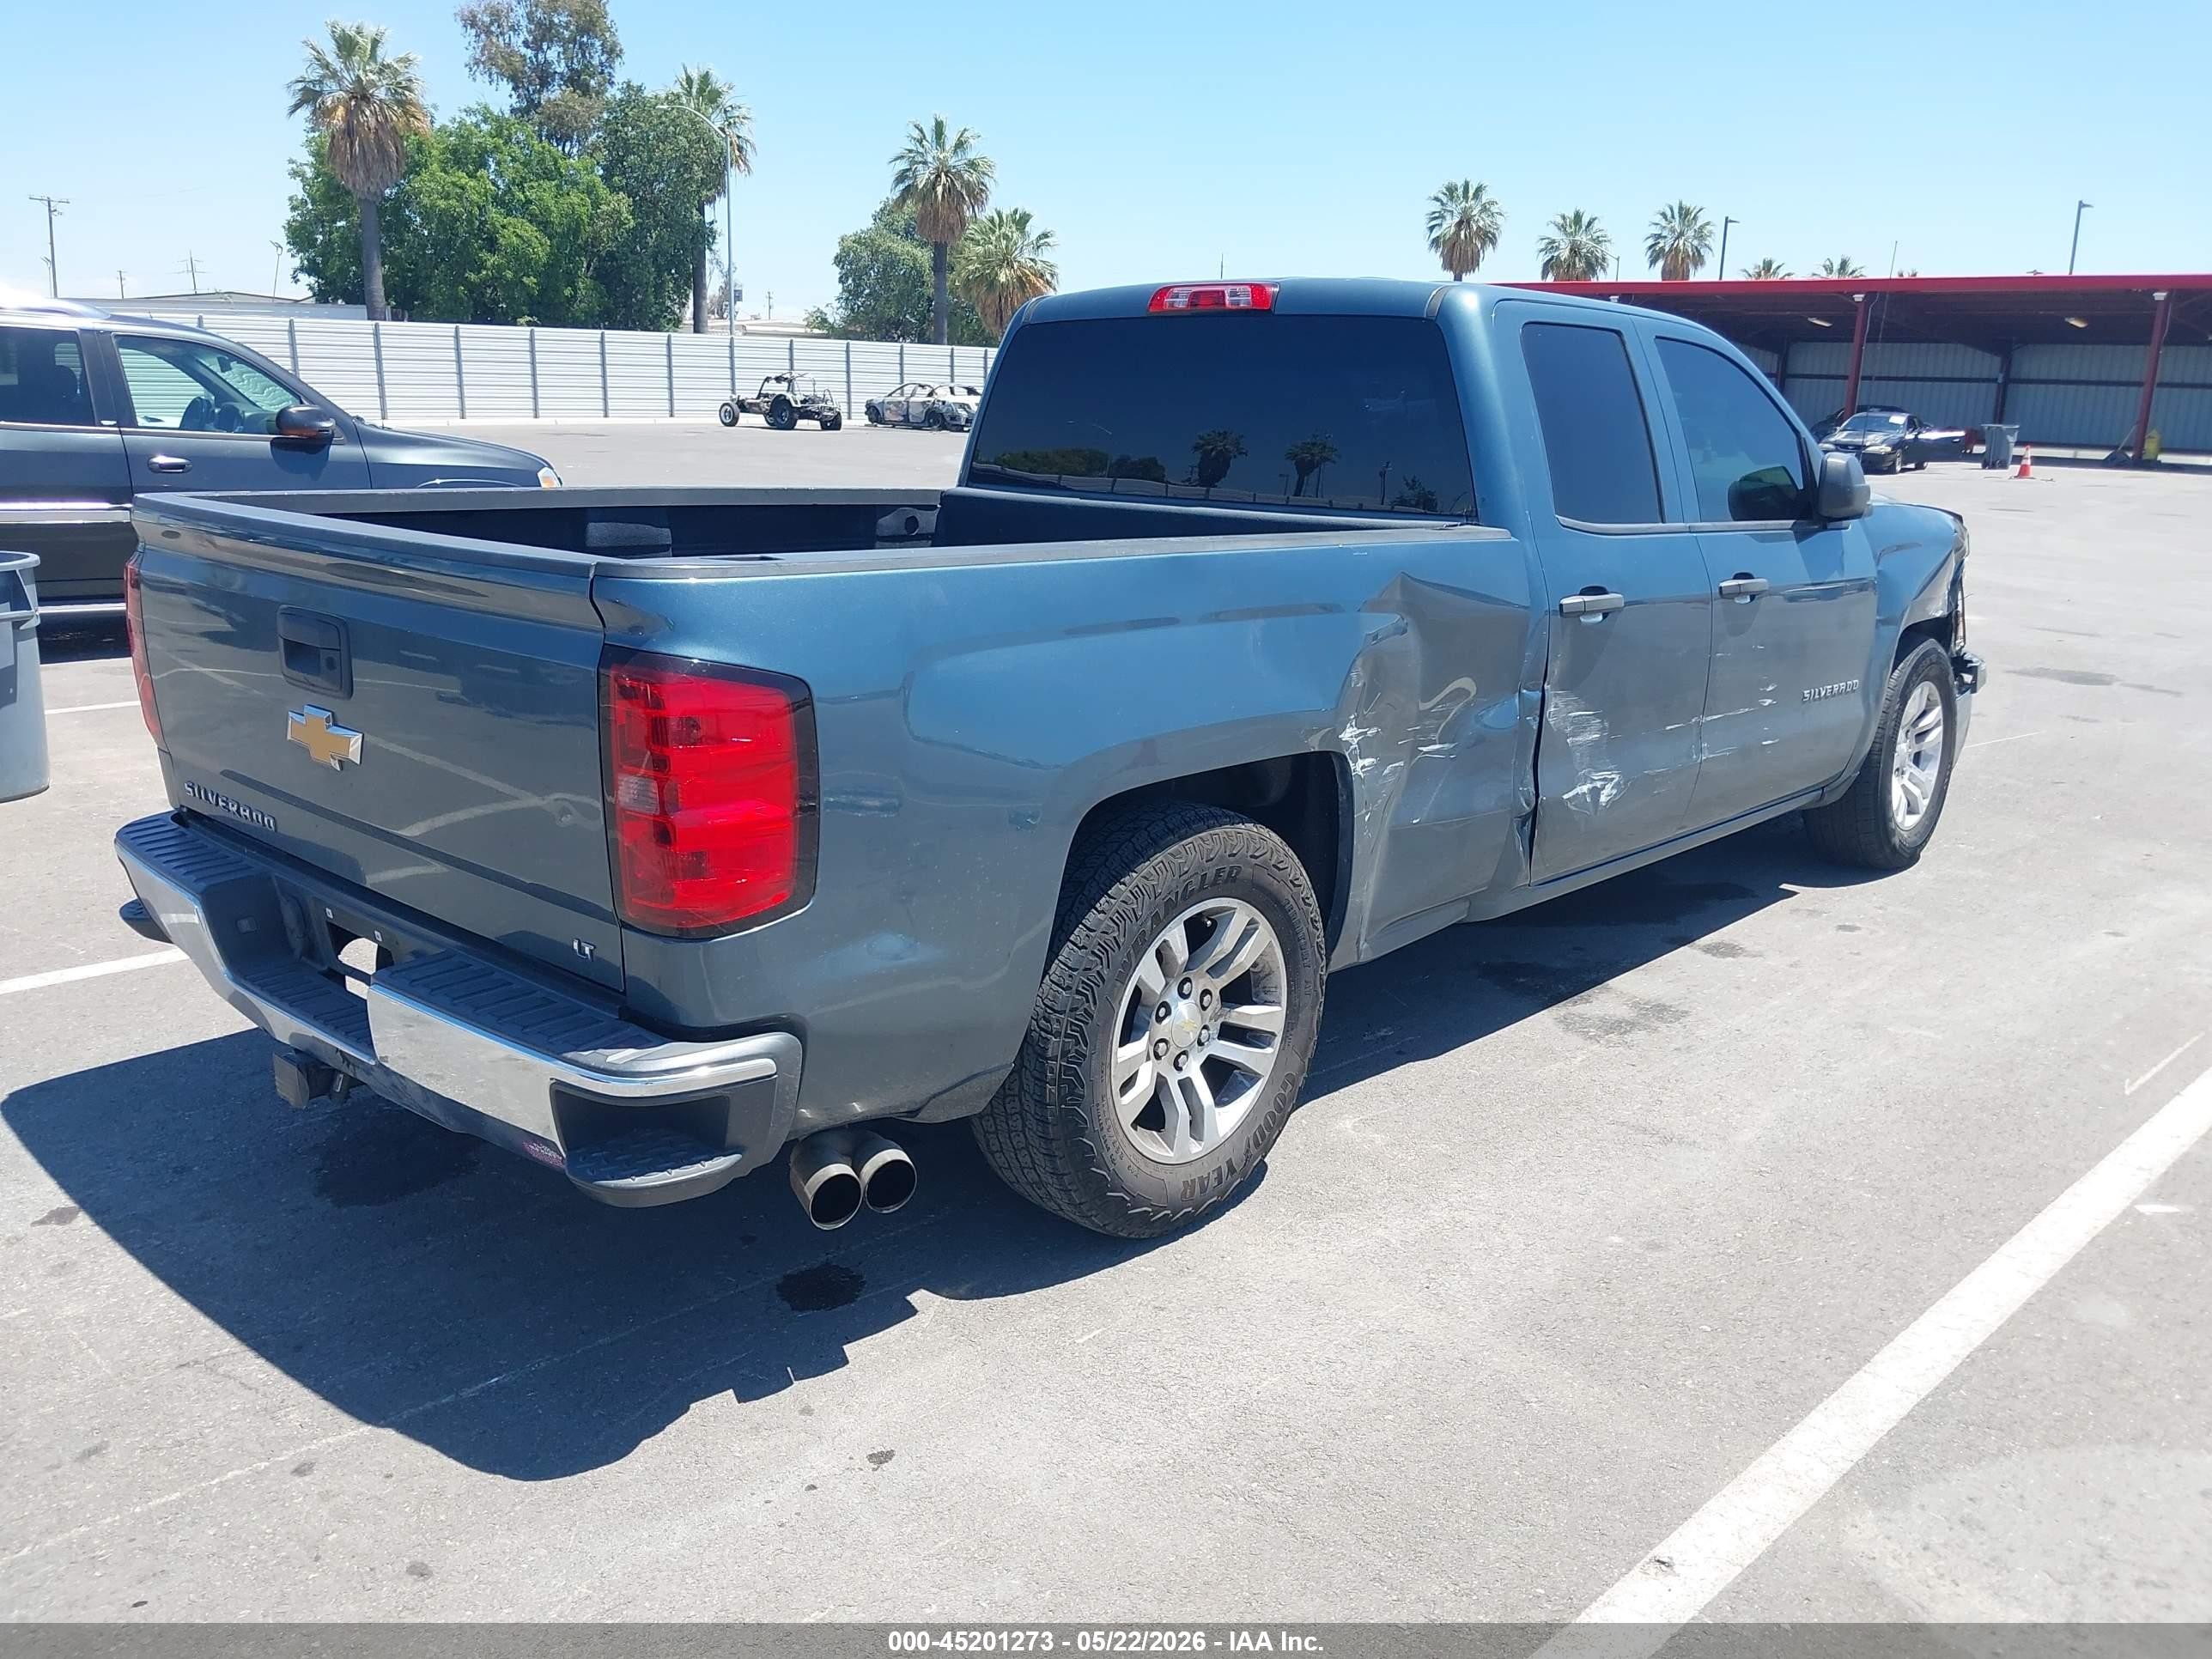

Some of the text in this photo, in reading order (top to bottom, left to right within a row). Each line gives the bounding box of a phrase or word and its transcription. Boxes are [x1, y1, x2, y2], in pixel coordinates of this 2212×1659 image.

[1802, 679, 1859, 702] SILVERADO
[184, 780, 277, 832] SILVERADO
[1115, 865, 1243, 985] WRANGLER
[573, 939, 595, 961] LT
